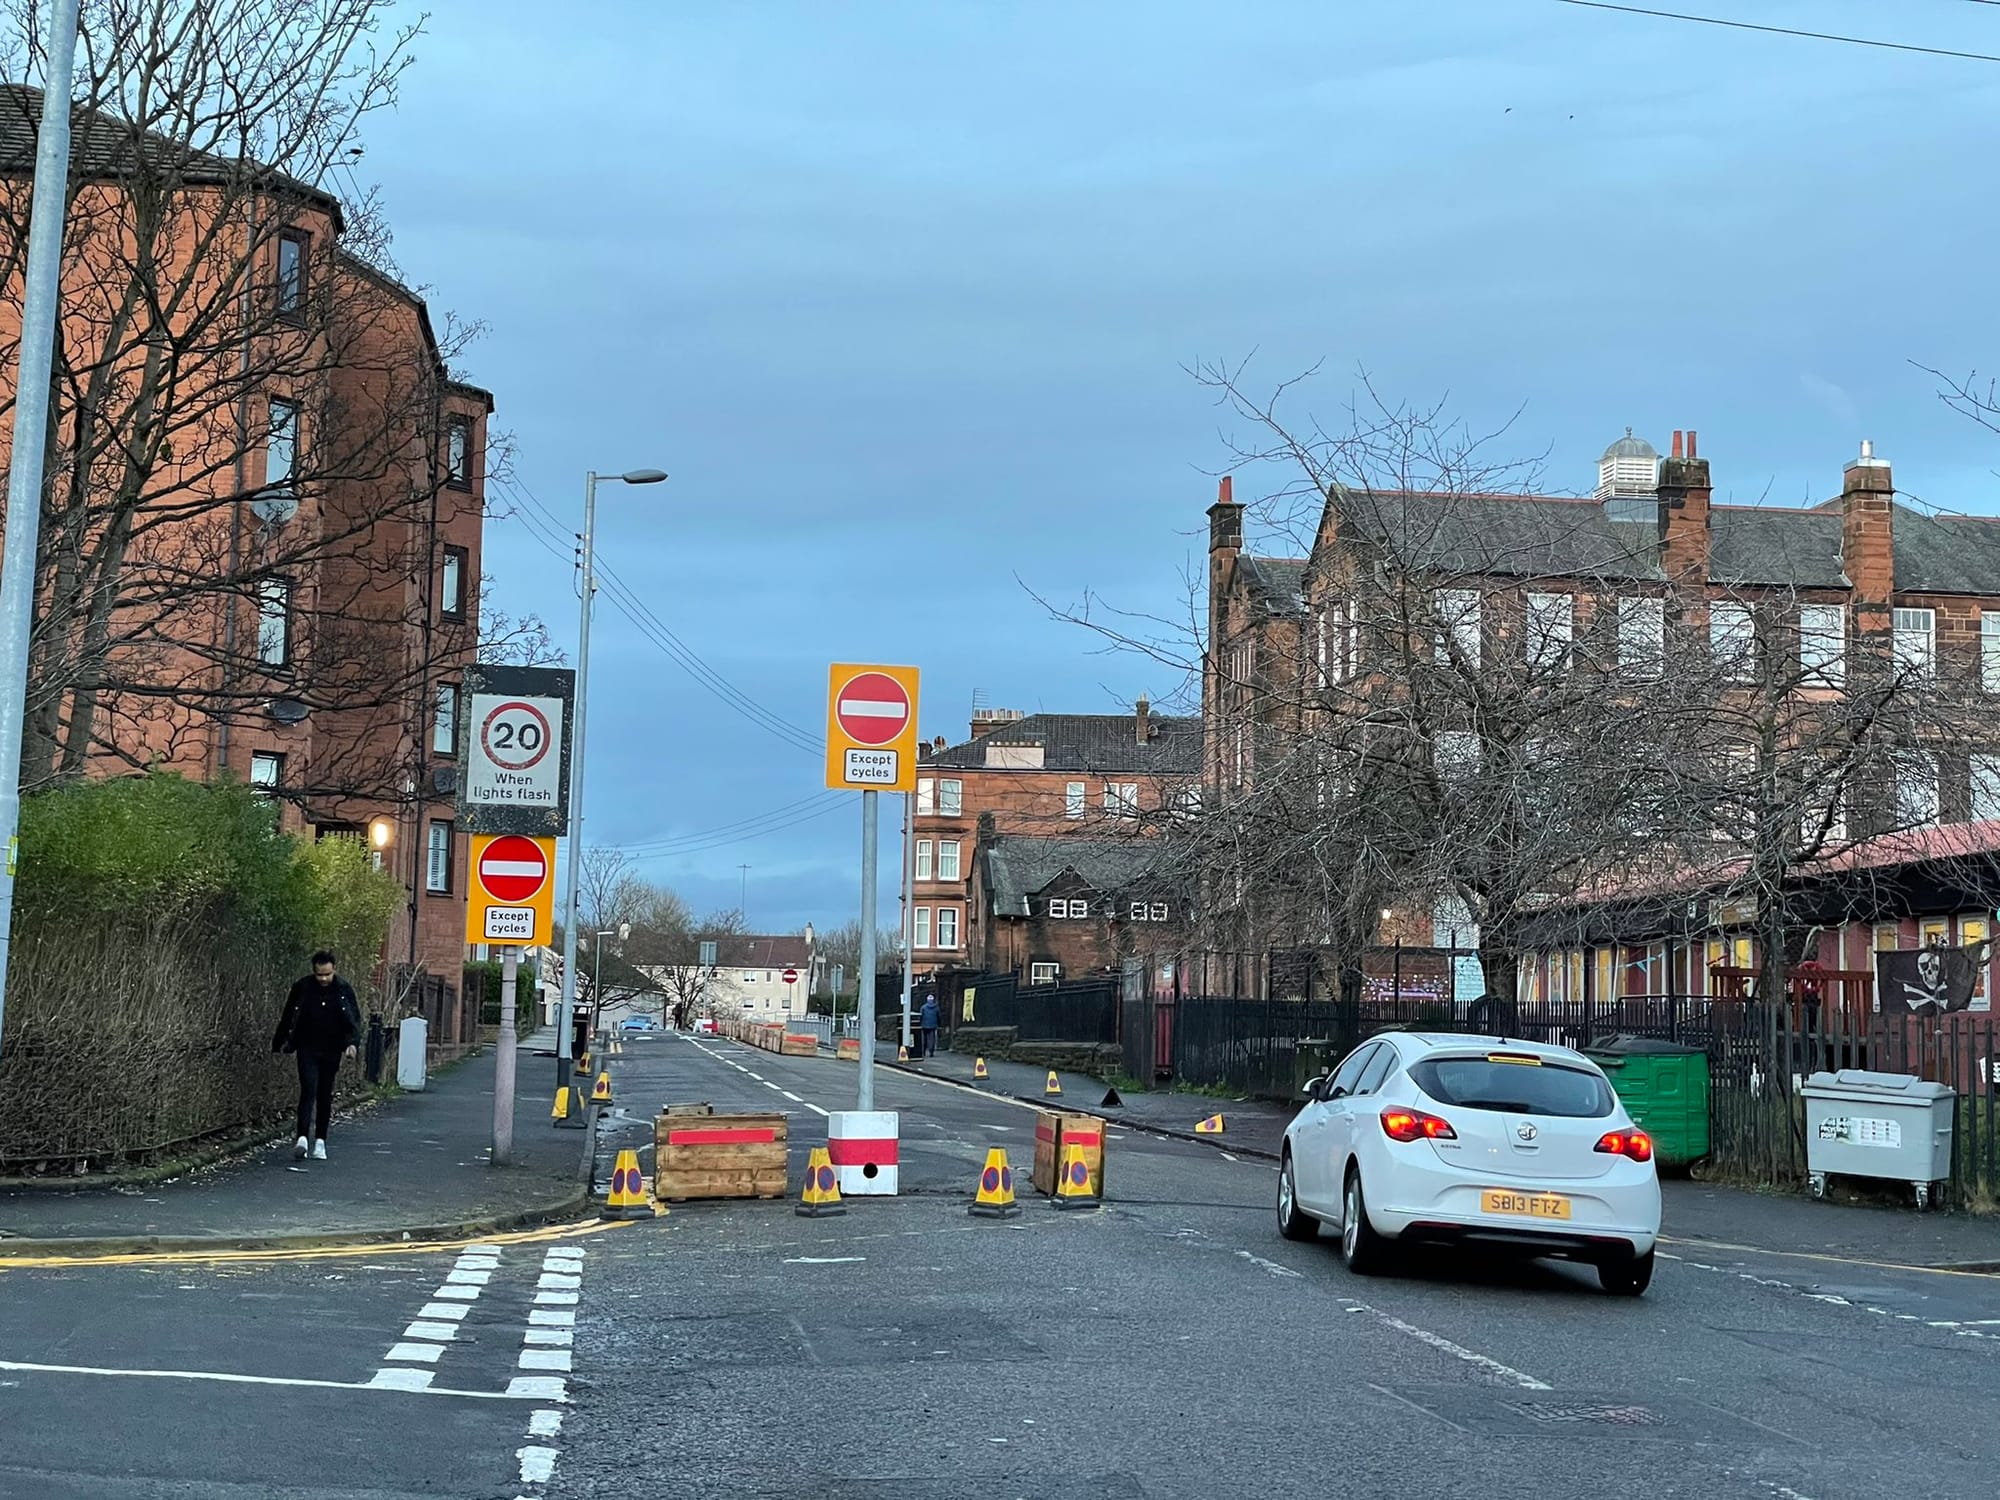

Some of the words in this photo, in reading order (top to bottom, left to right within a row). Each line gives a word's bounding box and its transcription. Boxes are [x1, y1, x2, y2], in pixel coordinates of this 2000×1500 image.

[493, 722, 541, 751] 20
[850, 753, 892, 765] Except
[851, 767, 889, 778] cycles
[495, 773, 533, 785] When
[474, 786, 513, 800] lights
[518, 788, 551, 800] flash
[490, 910, 529, 921] Except
[491, 923, 527, 934] cycles
[1491, 1194, 1526, 1211] SB13
[1530, 1198, 1561, 1215] FTZ
